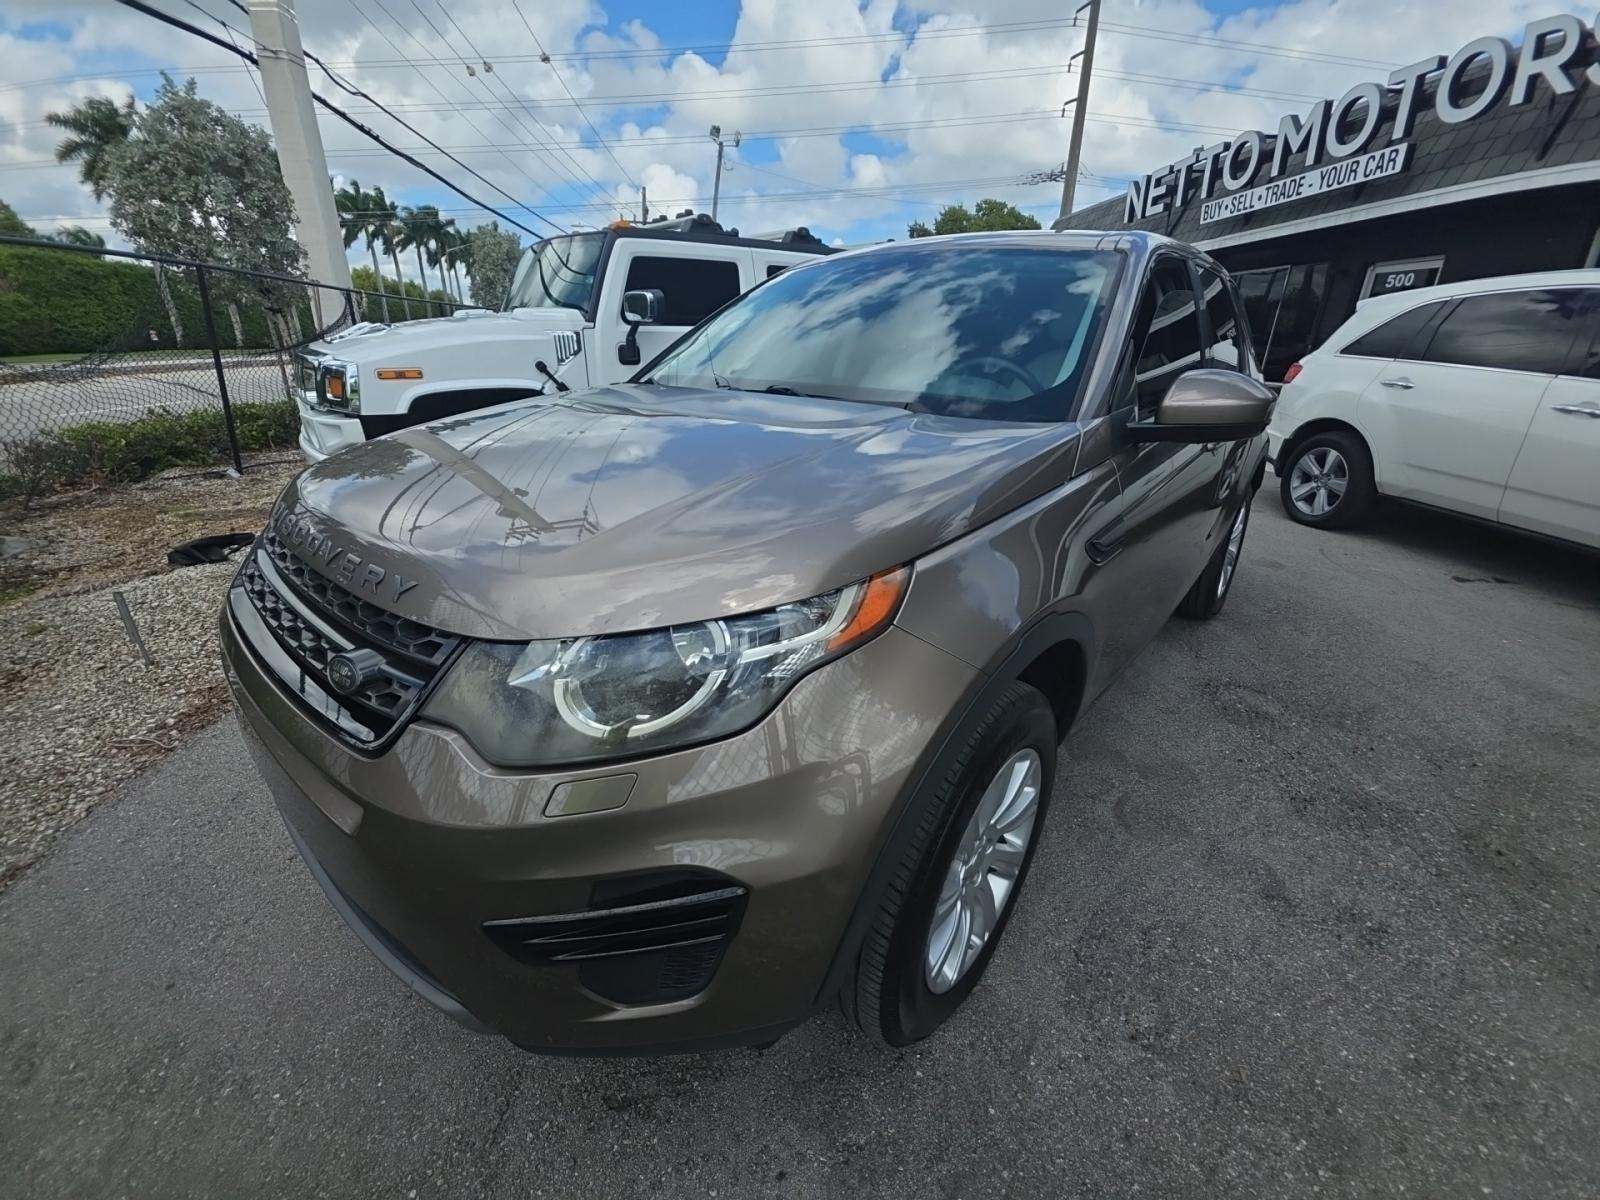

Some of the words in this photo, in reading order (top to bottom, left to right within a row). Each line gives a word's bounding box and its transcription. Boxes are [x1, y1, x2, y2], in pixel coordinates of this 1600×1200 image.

[1123, 130, 1263, 223] NETTO
[1319, 159, 1358, 191] YOUR
[1363, 148, 1399, 178] CAR
[1385, 272, 1415, 288] 500
